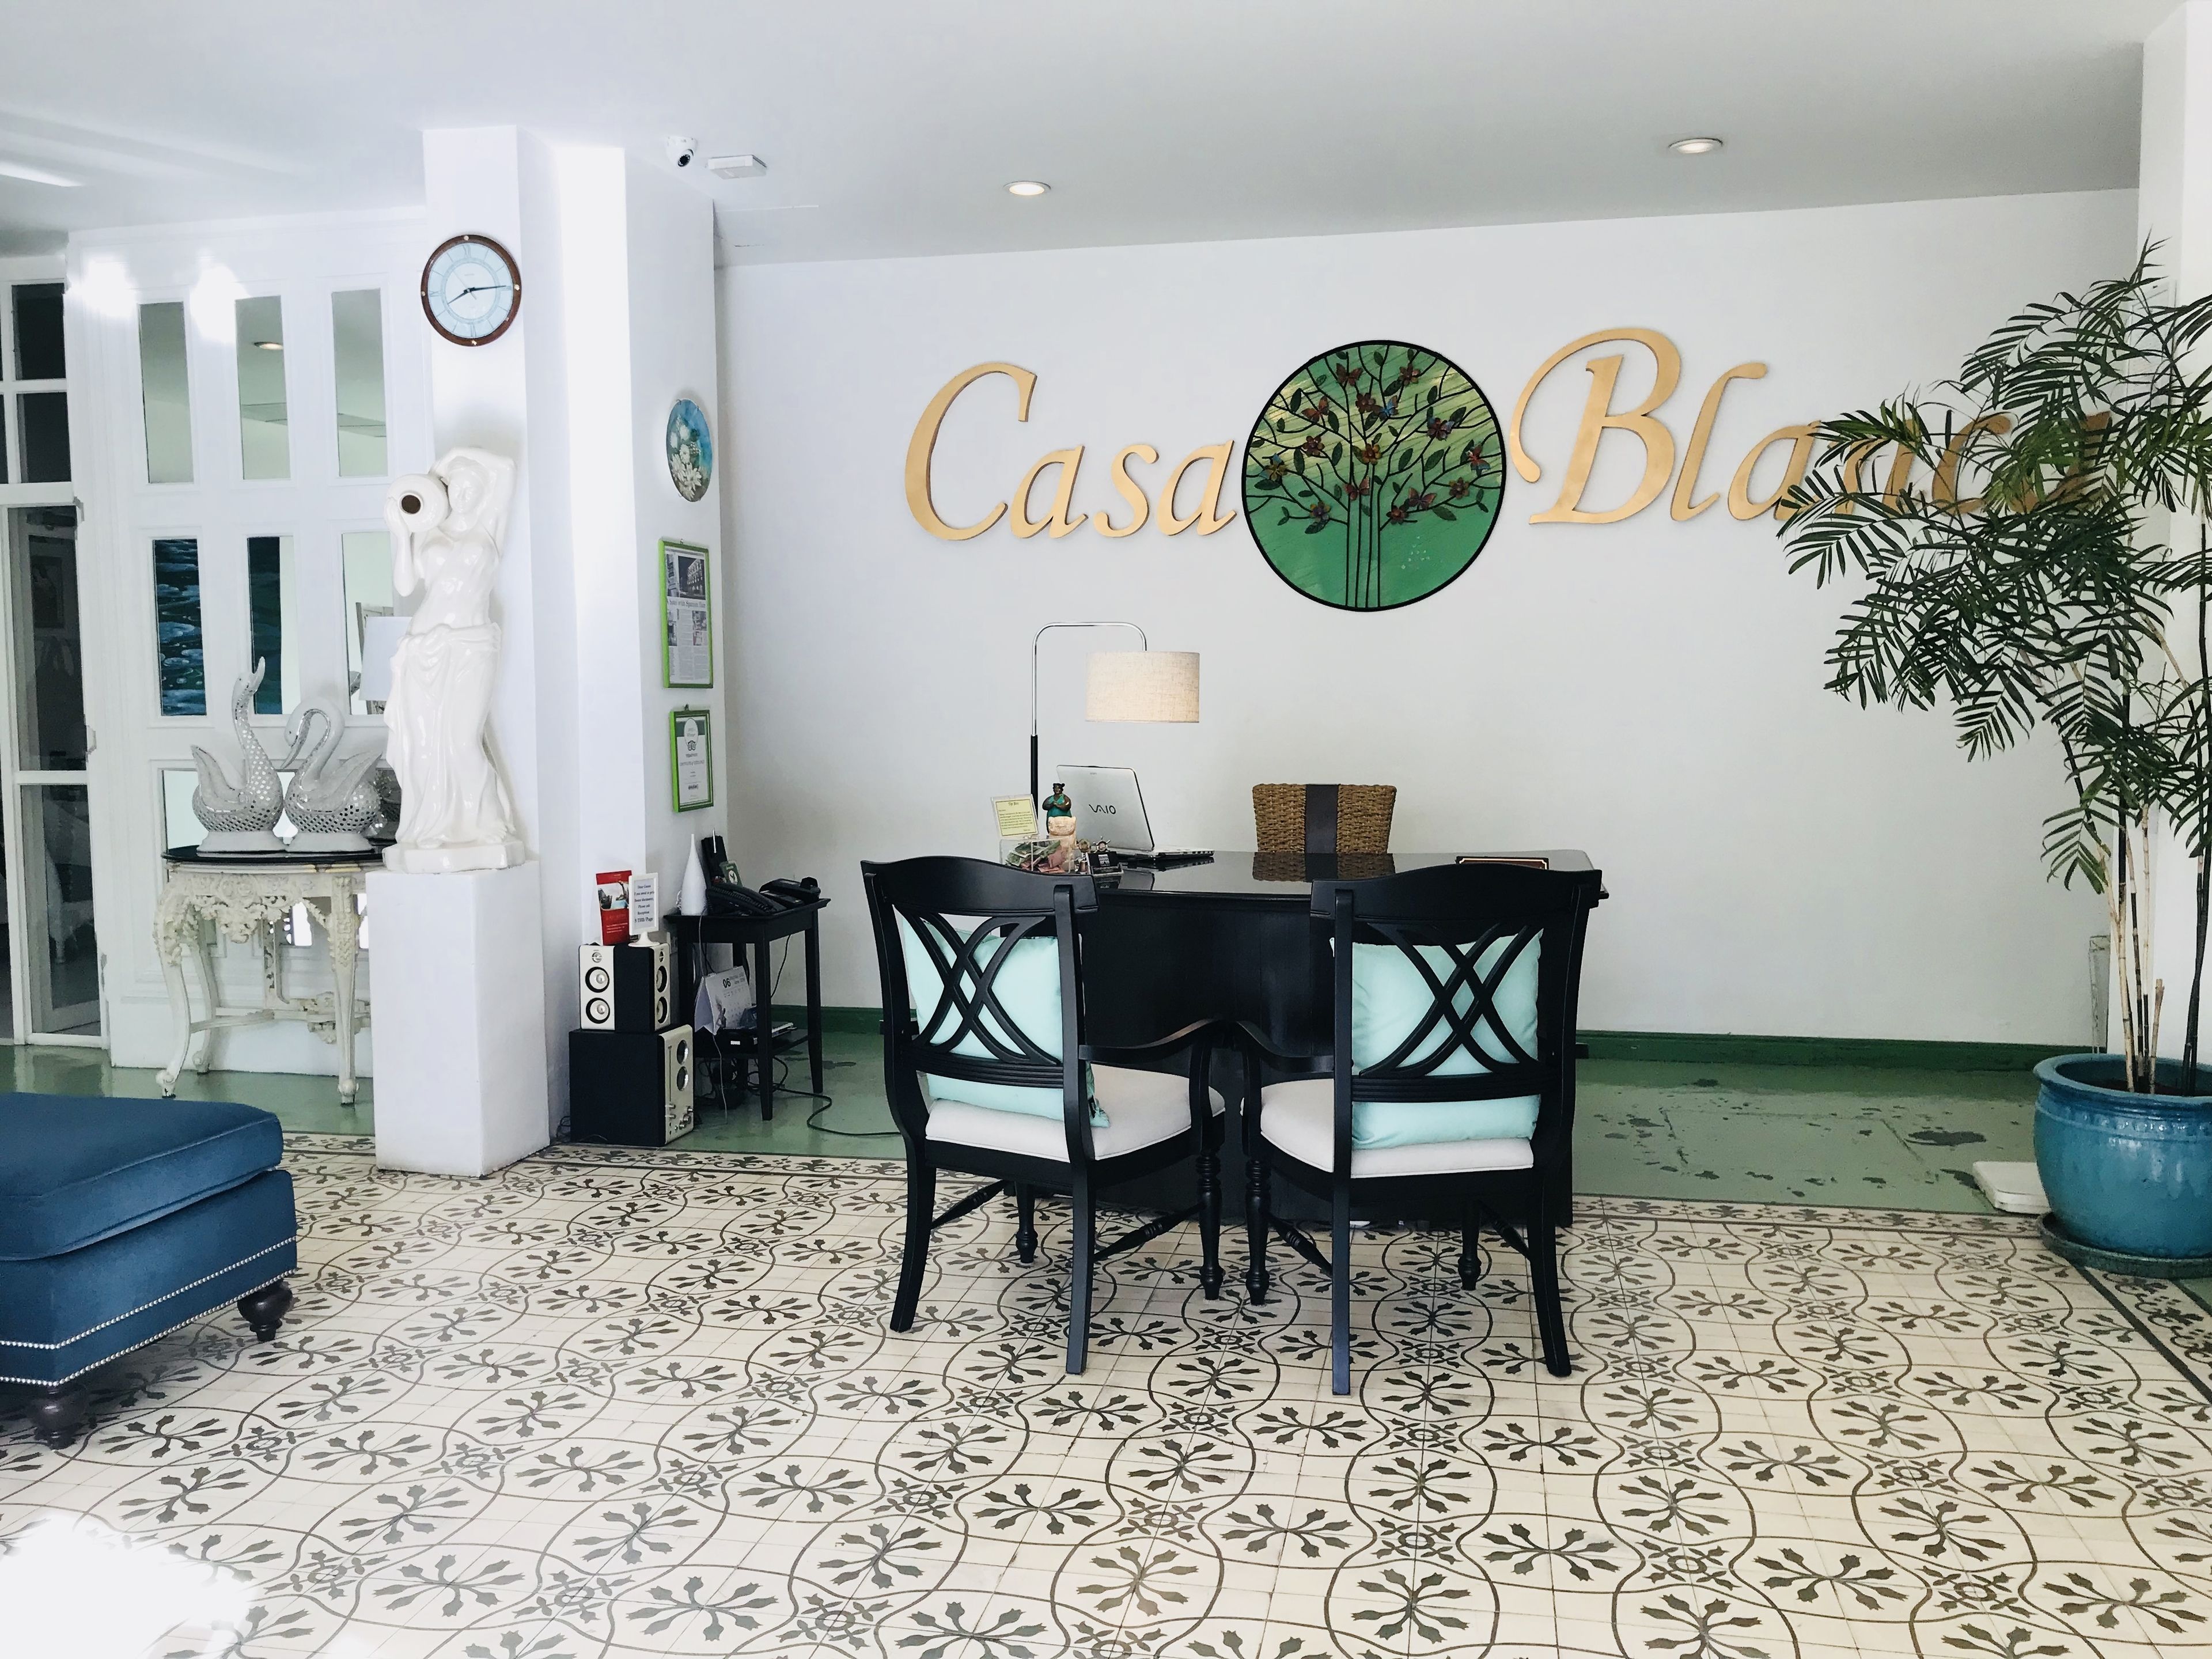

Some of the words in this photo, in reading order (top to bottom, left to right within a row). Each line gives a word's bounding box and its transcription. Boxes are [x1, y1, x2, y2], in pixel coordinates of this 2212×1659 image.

[905, 362, 1237, 540] Casa
[1088, 804, 1116, 815] VAIO
[723, 978, 731, 988] 06
